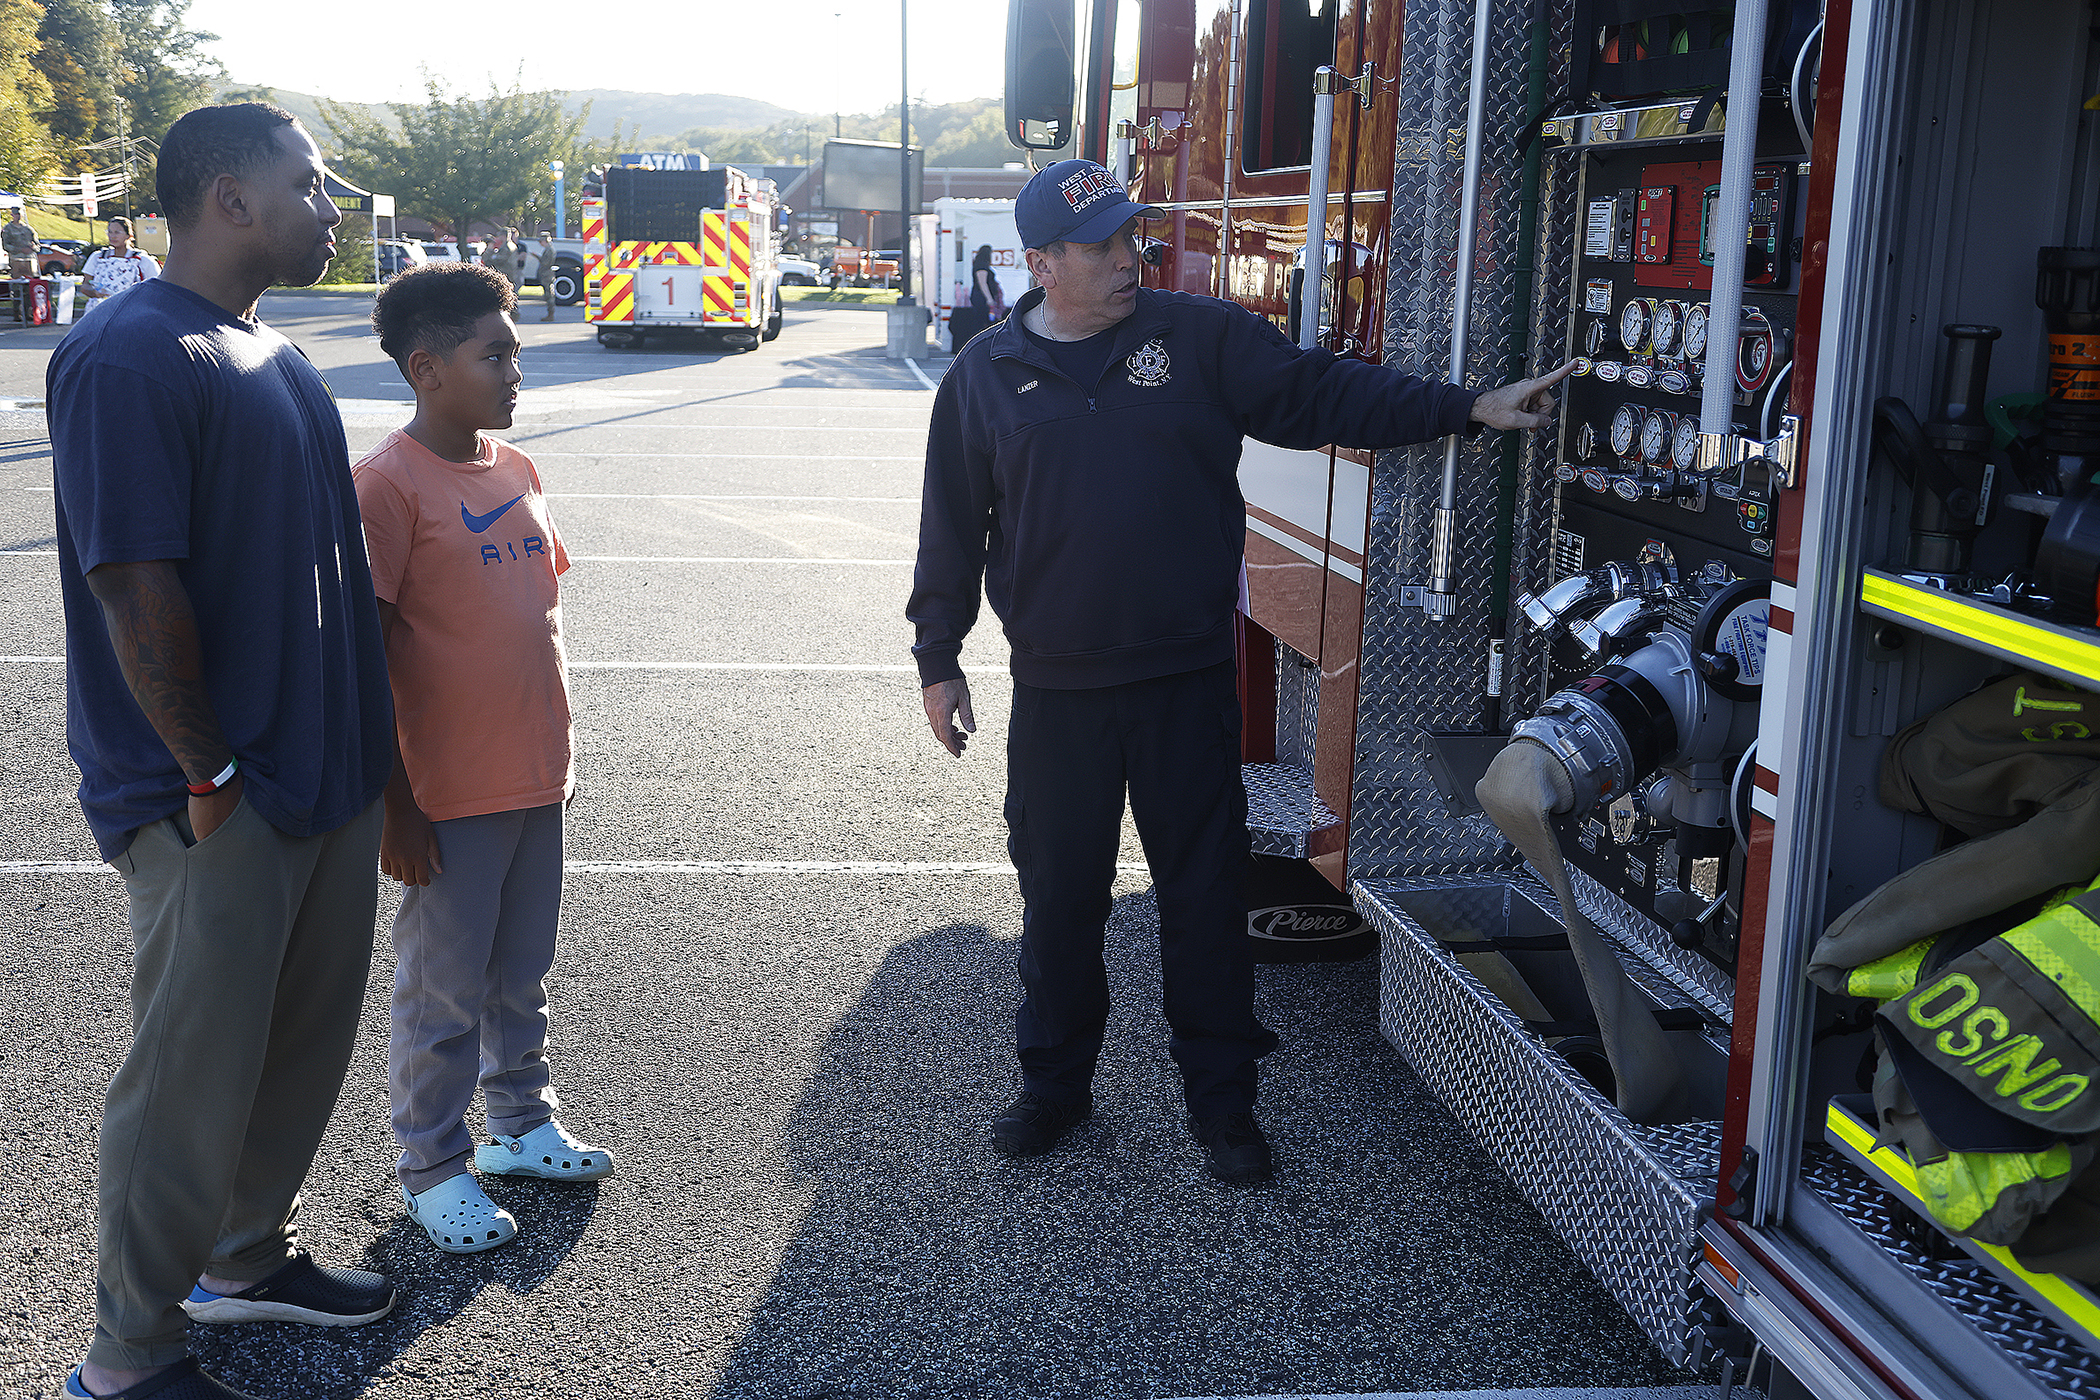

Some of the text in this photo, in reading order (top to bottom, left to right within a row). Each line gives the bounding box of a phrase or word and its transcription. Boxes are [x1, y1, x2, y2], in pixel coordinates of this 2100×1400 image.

[640, 154, 686, 171] ATM
[1057, 168, 1087, 190] WEST
[661, 276, 674, 306] 1
[480, 535, 546, 566] AIR
[1740, 615, 1761, 675] TASK FORCE TIPS
[1265, 909, 1348, 935] Pierce
